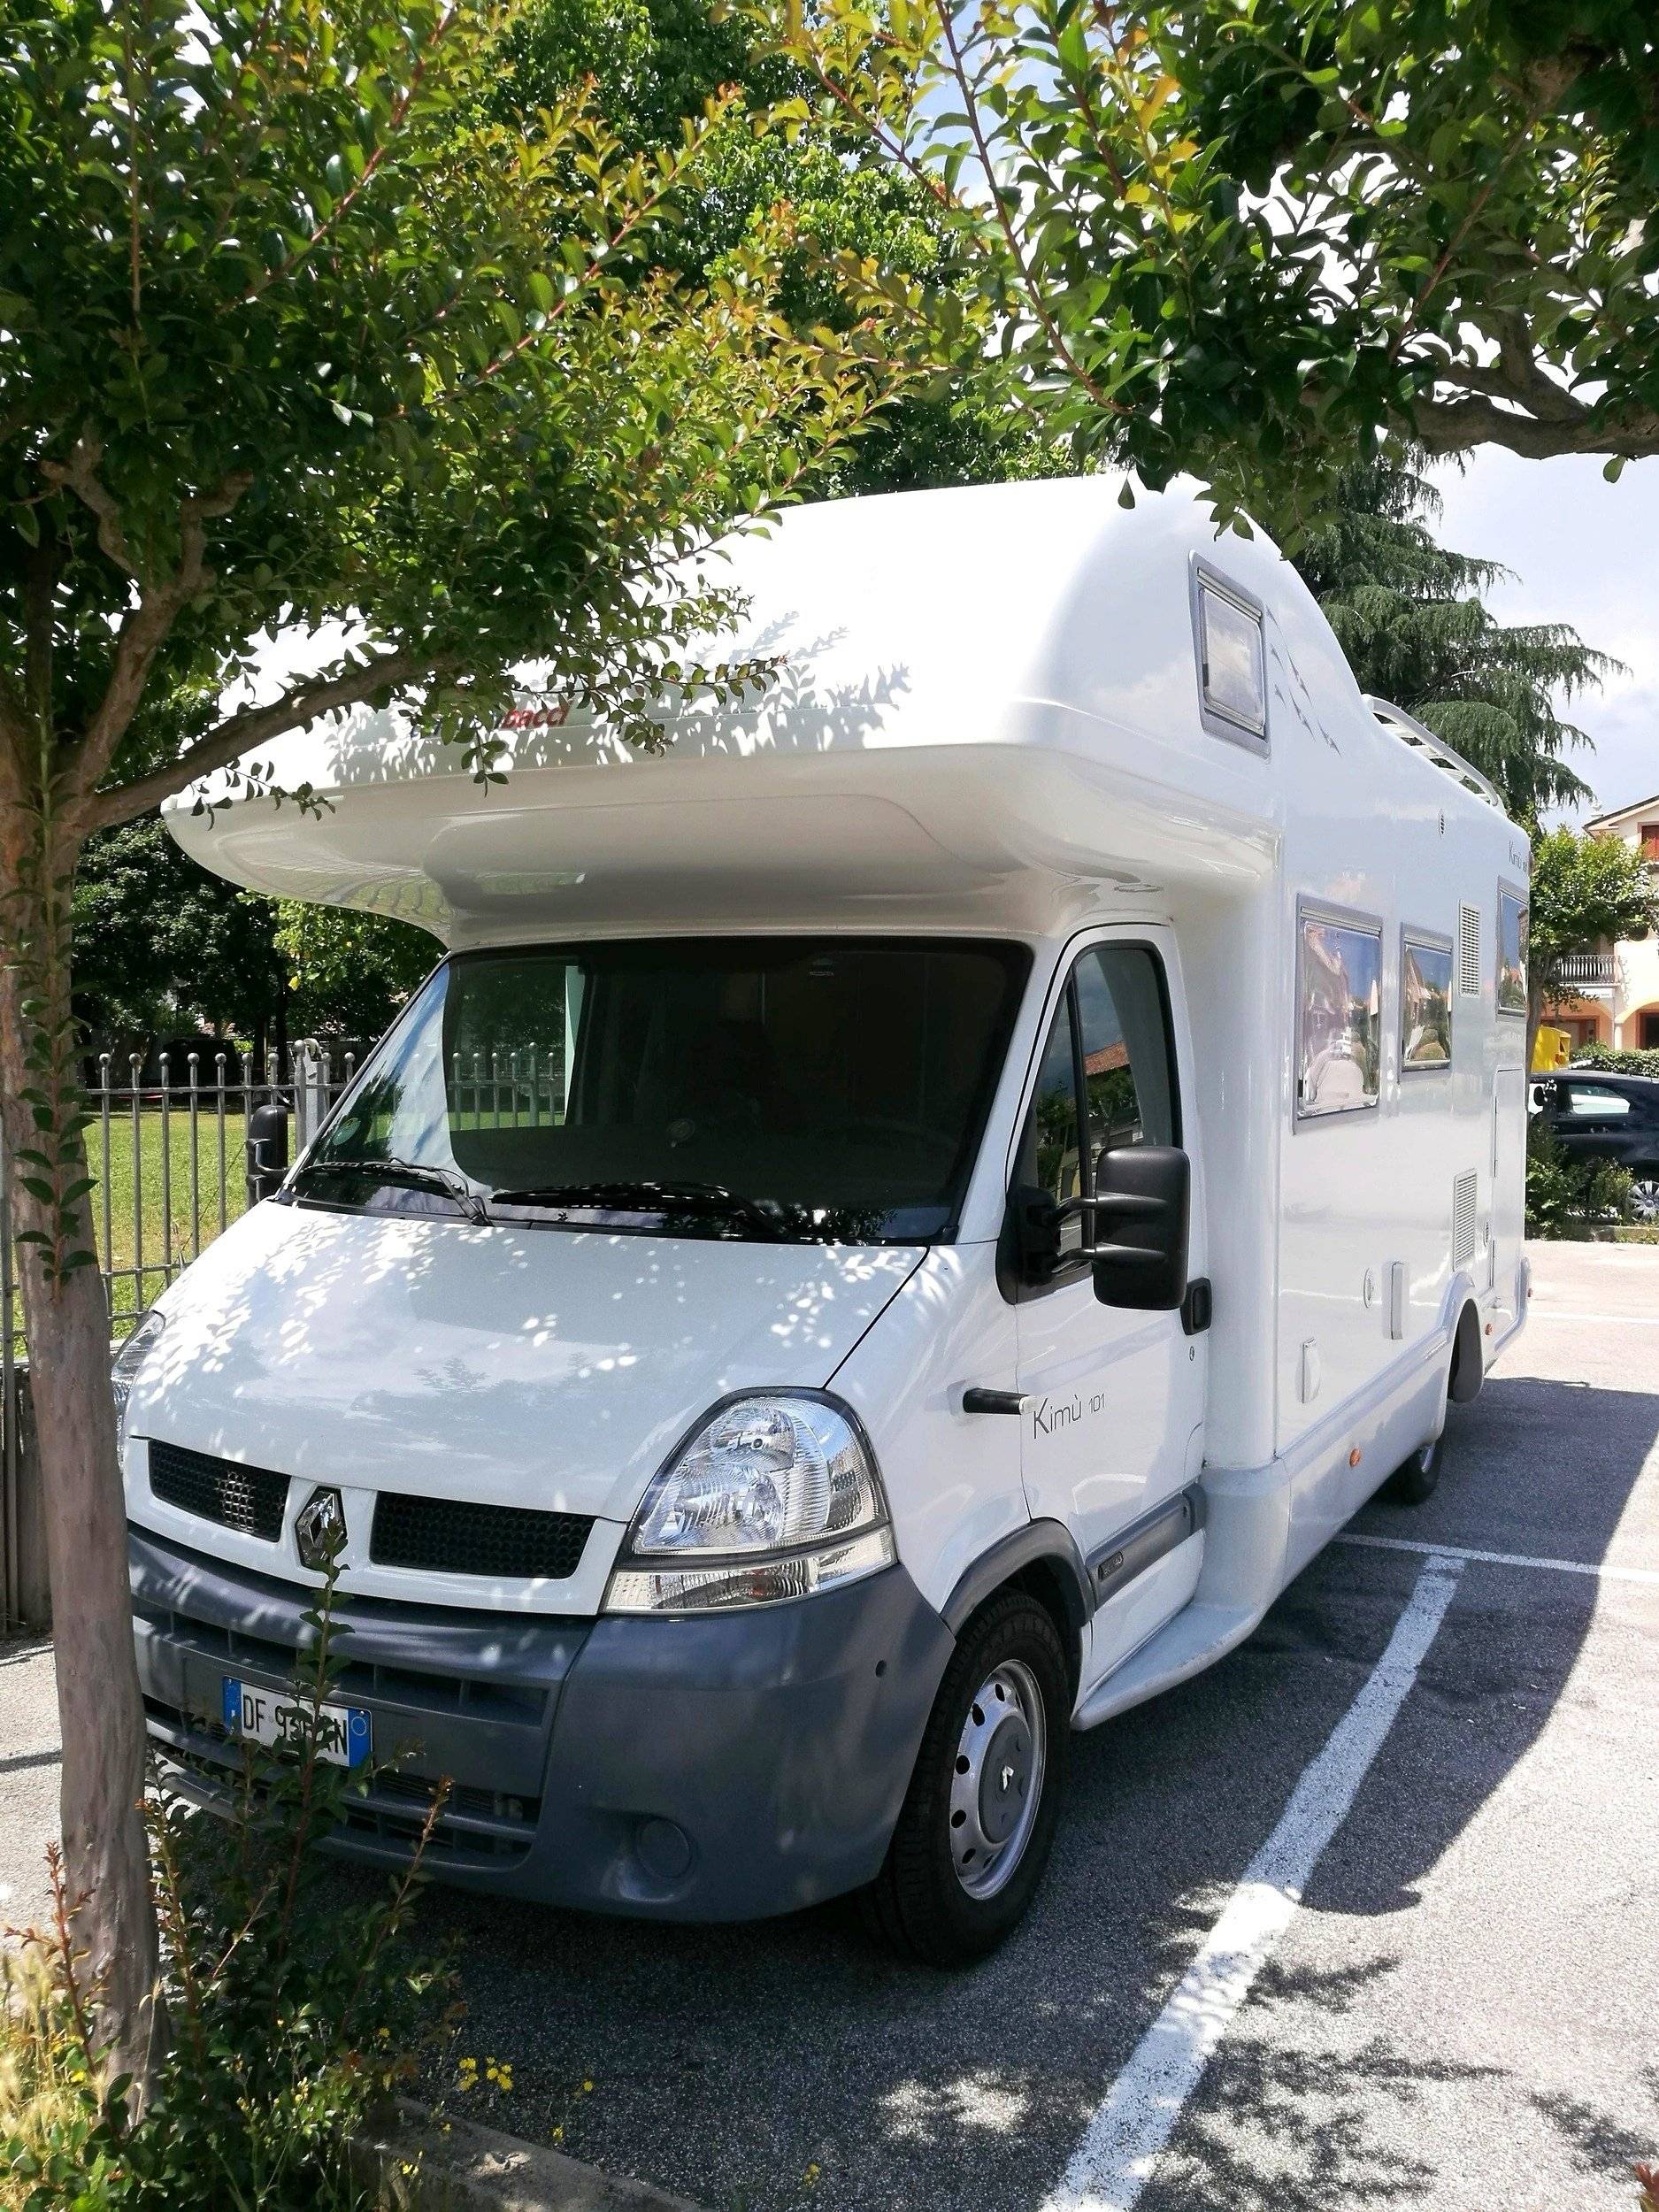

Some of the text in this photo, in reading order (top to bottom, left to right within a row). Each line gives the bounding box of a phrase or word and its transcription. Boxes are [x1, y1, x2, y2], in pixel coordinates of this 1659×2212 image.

[1033, 1393, 1105, 1440] Kimù 101
[242, 1694, 266, 1733] DF
